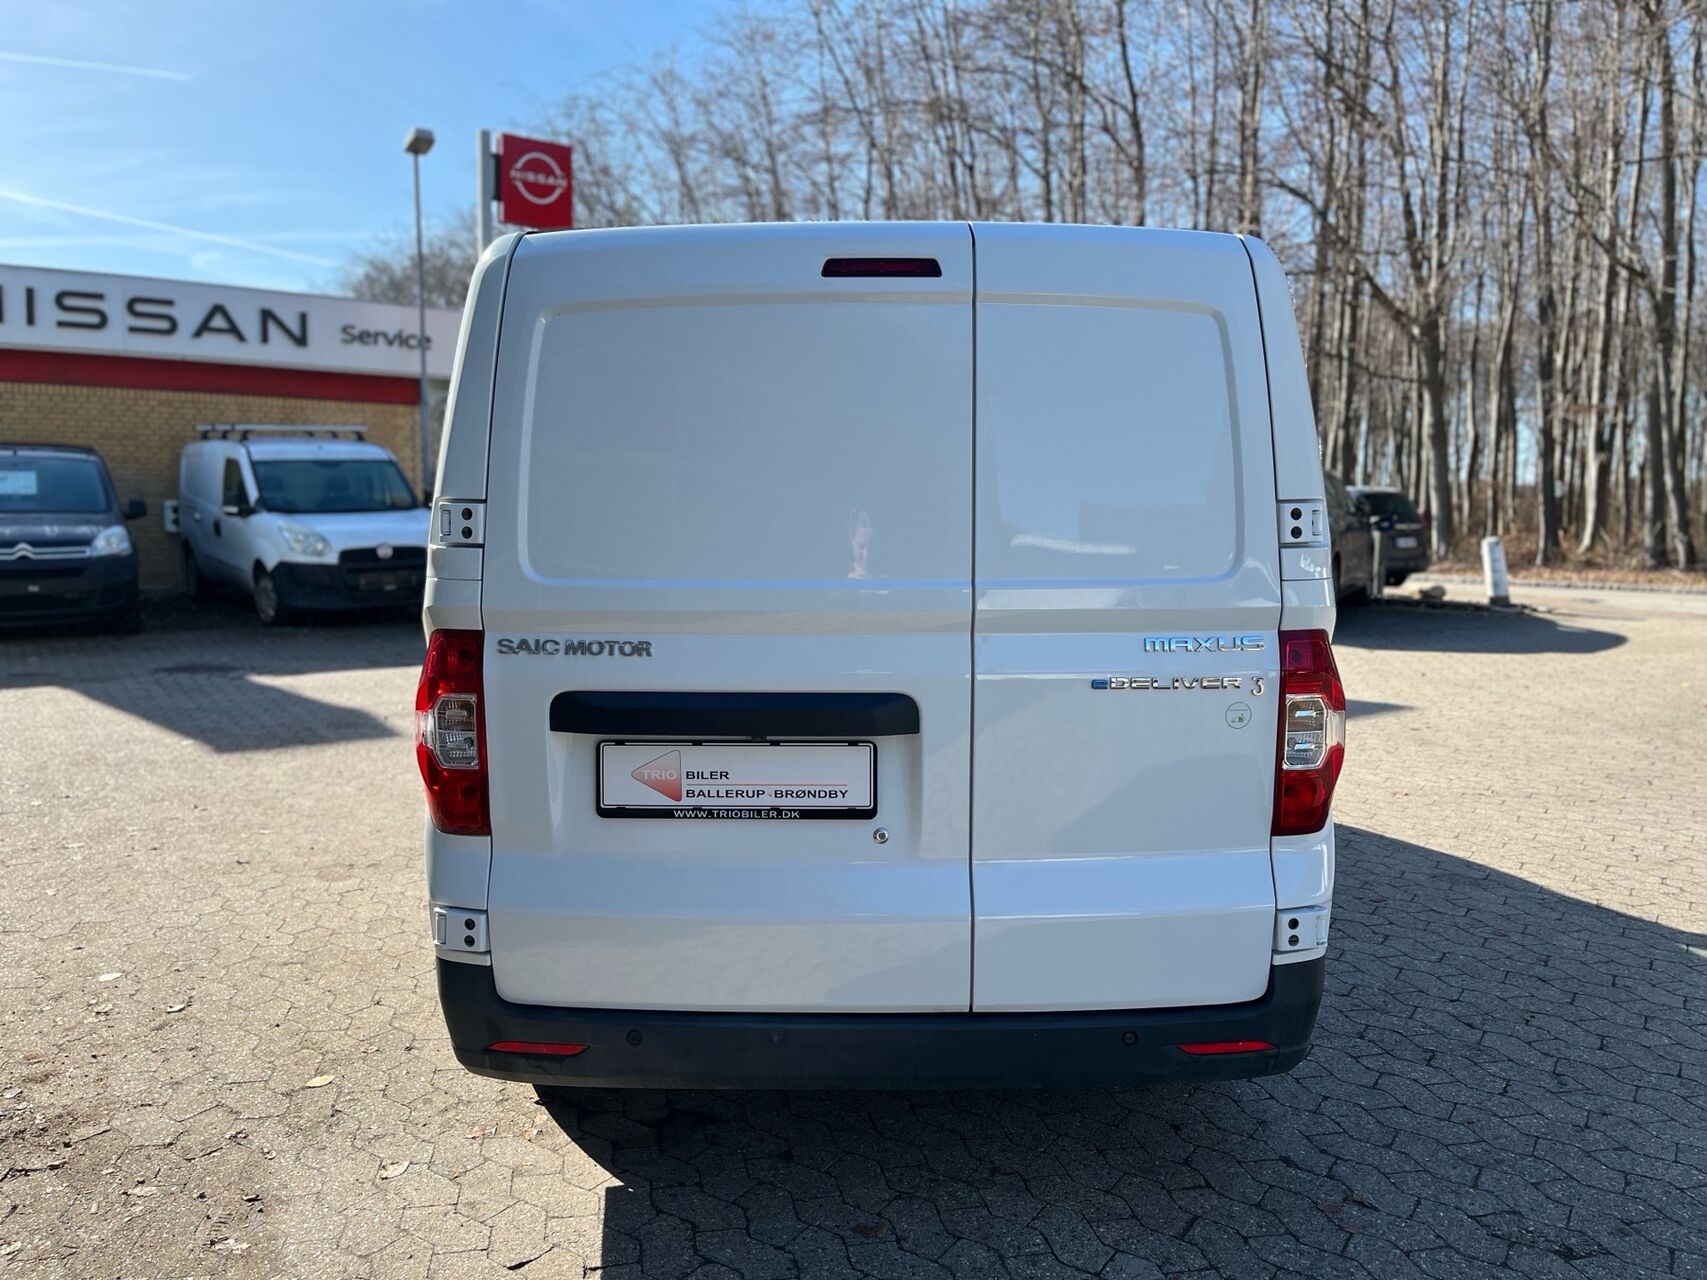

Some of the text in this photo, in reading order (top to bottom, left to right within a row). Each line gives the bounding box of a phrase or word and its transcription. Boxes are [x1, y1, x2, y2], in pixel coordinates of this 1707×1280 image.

[0, 284, 309, 347] ISSAN
[496, 638, 653, 658] SAIC MOTOR
[1143, 635, 1265, 653] MAXUS
[1251, 676, 1265, 697] 3
[641, 769, 730, 781] TRIO BILER
[685, 789, 848, 799] BALLERUP BRØNDBY
[673, 809, 801, 819] WWW.TRIOBILER.DK
